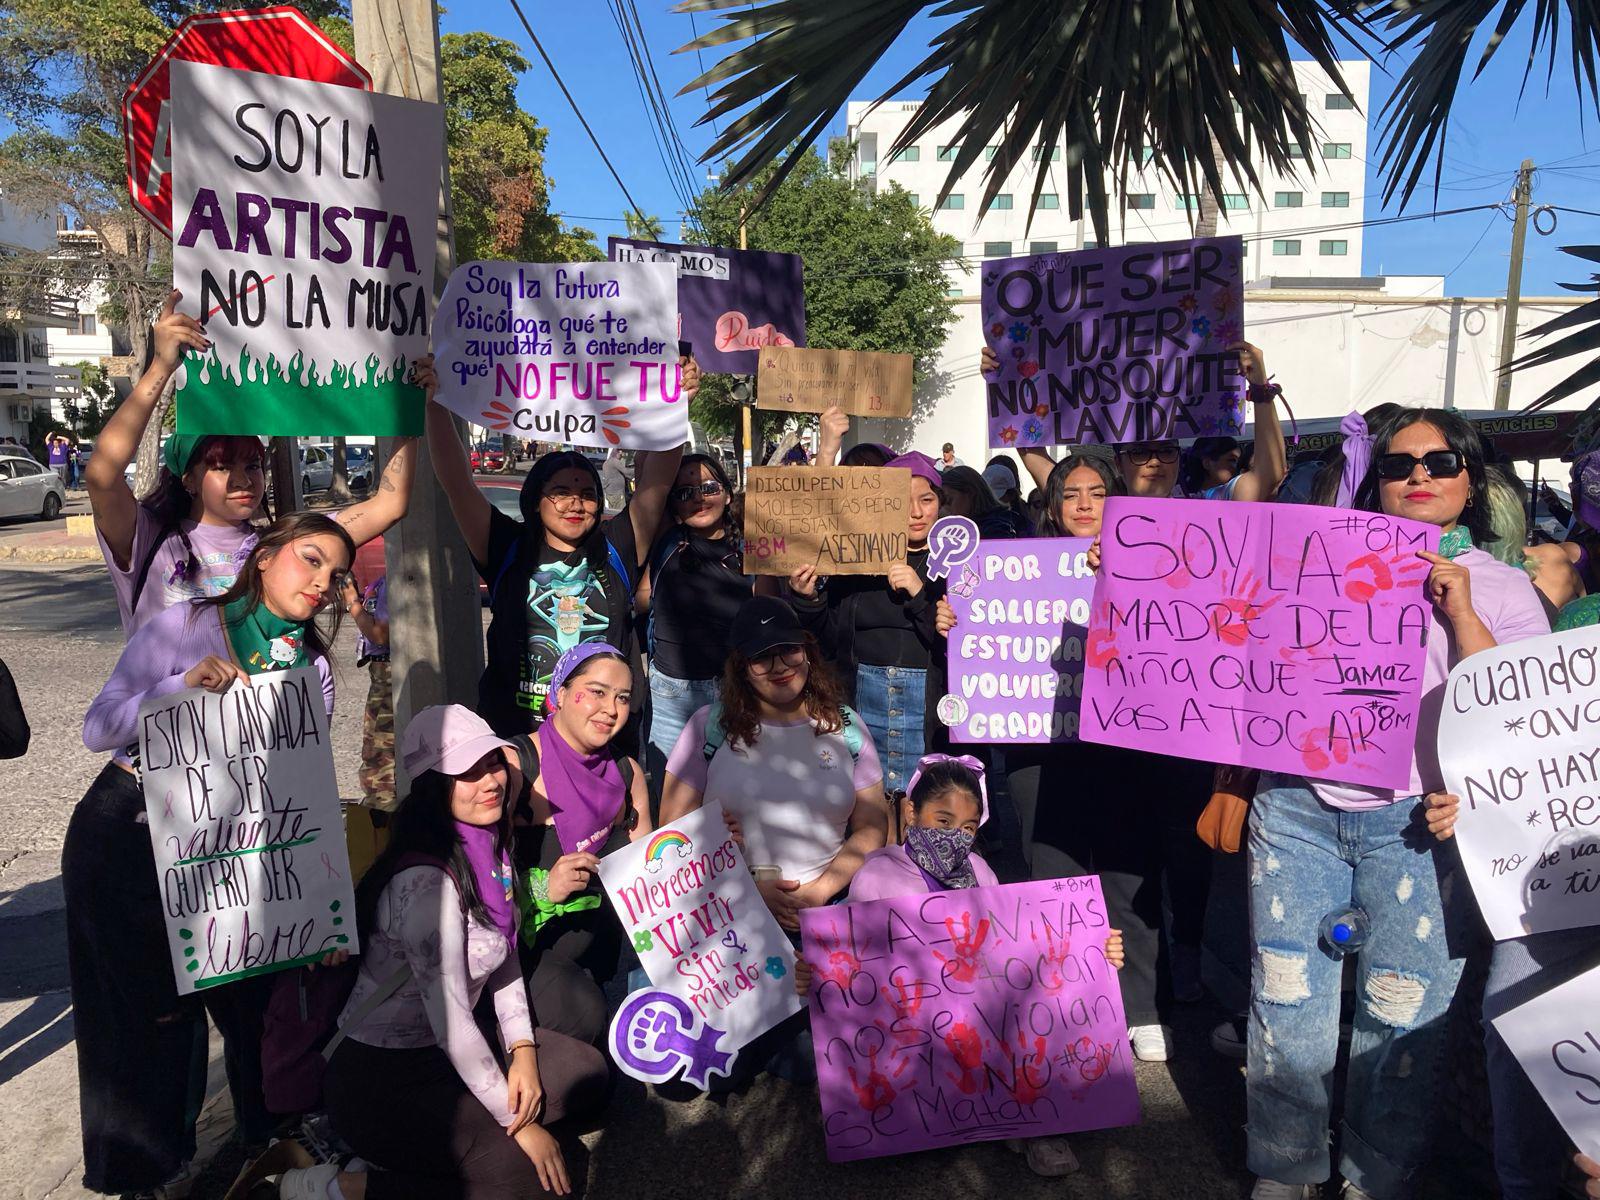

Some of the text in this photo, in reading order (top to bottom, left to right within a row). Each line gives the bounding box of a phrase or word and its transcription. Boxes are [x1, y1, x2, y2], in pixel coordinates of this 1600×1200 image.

[234, 103, 331, 175] SOY
[342, 119, 384, 182] LA
[466, 264, 620, 309] Soy la futura
[1120, 246, 1231, 302] SER
[200, 268, 427, 336] NO LA MUSA
[456, 297, 628, 343] Psicóloga qué te
[563, 340, 576, 355] a
[586, 336, 666, 356] entender
[1038, 307, 1190, 370] MUJER
[452, 358, 682, 404] qué NO FUE TU
[988, 352, 1241, 418] NO NOS QUITE
[512, 408, 597, 441] Culpa
[1053, 405, 1105, 445] LA
[1476, 415, 1557, 434] EVICHES
[755, 474, 881, 493] DISCULPEN LAS
[865, 497, 901, 514] PERO
[755, 518, 839, 536] NOS ESTAN
[744, 532, 907, 570] #8M ASESINANDO
[1111, 511, 1427, 597] SOY LA #8M
[969, 598, 1090, 625] SALIERO
[1109, 598, 1431, 649] MADRE DE LA
[960, 634, 1087, 664] ESTUDIA
[1209, 655, 1298, 696] QUE
[144, 677, 320, 772] ESTOY CANSADA
[968, 711, 1080, 739] GRADUA
[1181, 698, 1210, 733] A
[1208, 703, 1386, 754] TOCAR
[1365, 700, 1411, 730] #8M
[186, 756, 277, 824] DE SER
[1464, 747, 1600, 810] NO HAY
[166, 796, 322, 862] valiente
[1547, 795, 1600, 832] Re
[164, 847, 302, 919] QUIERO SER
[1052, 878, 1095, 892] #8M
[1492, 853, 1528, 878] no
[1535, 849, 1560, 869] se
[1530, 877, 1551, 891] a
[199, 910, 346, 980] libre
[849, 895, 975, 963] LAS
[689, 961, 760, 1019] miedo
[815, 970, 877, 1013] no
[978, 945, 1111, 992] tocan
[824, 1025, 886, 1065] no
[985, 1053, 1052, 1095] NO
[1060, 1037, 1127, 1082] #8M
[1552, 1031, 1600, 1105] S
